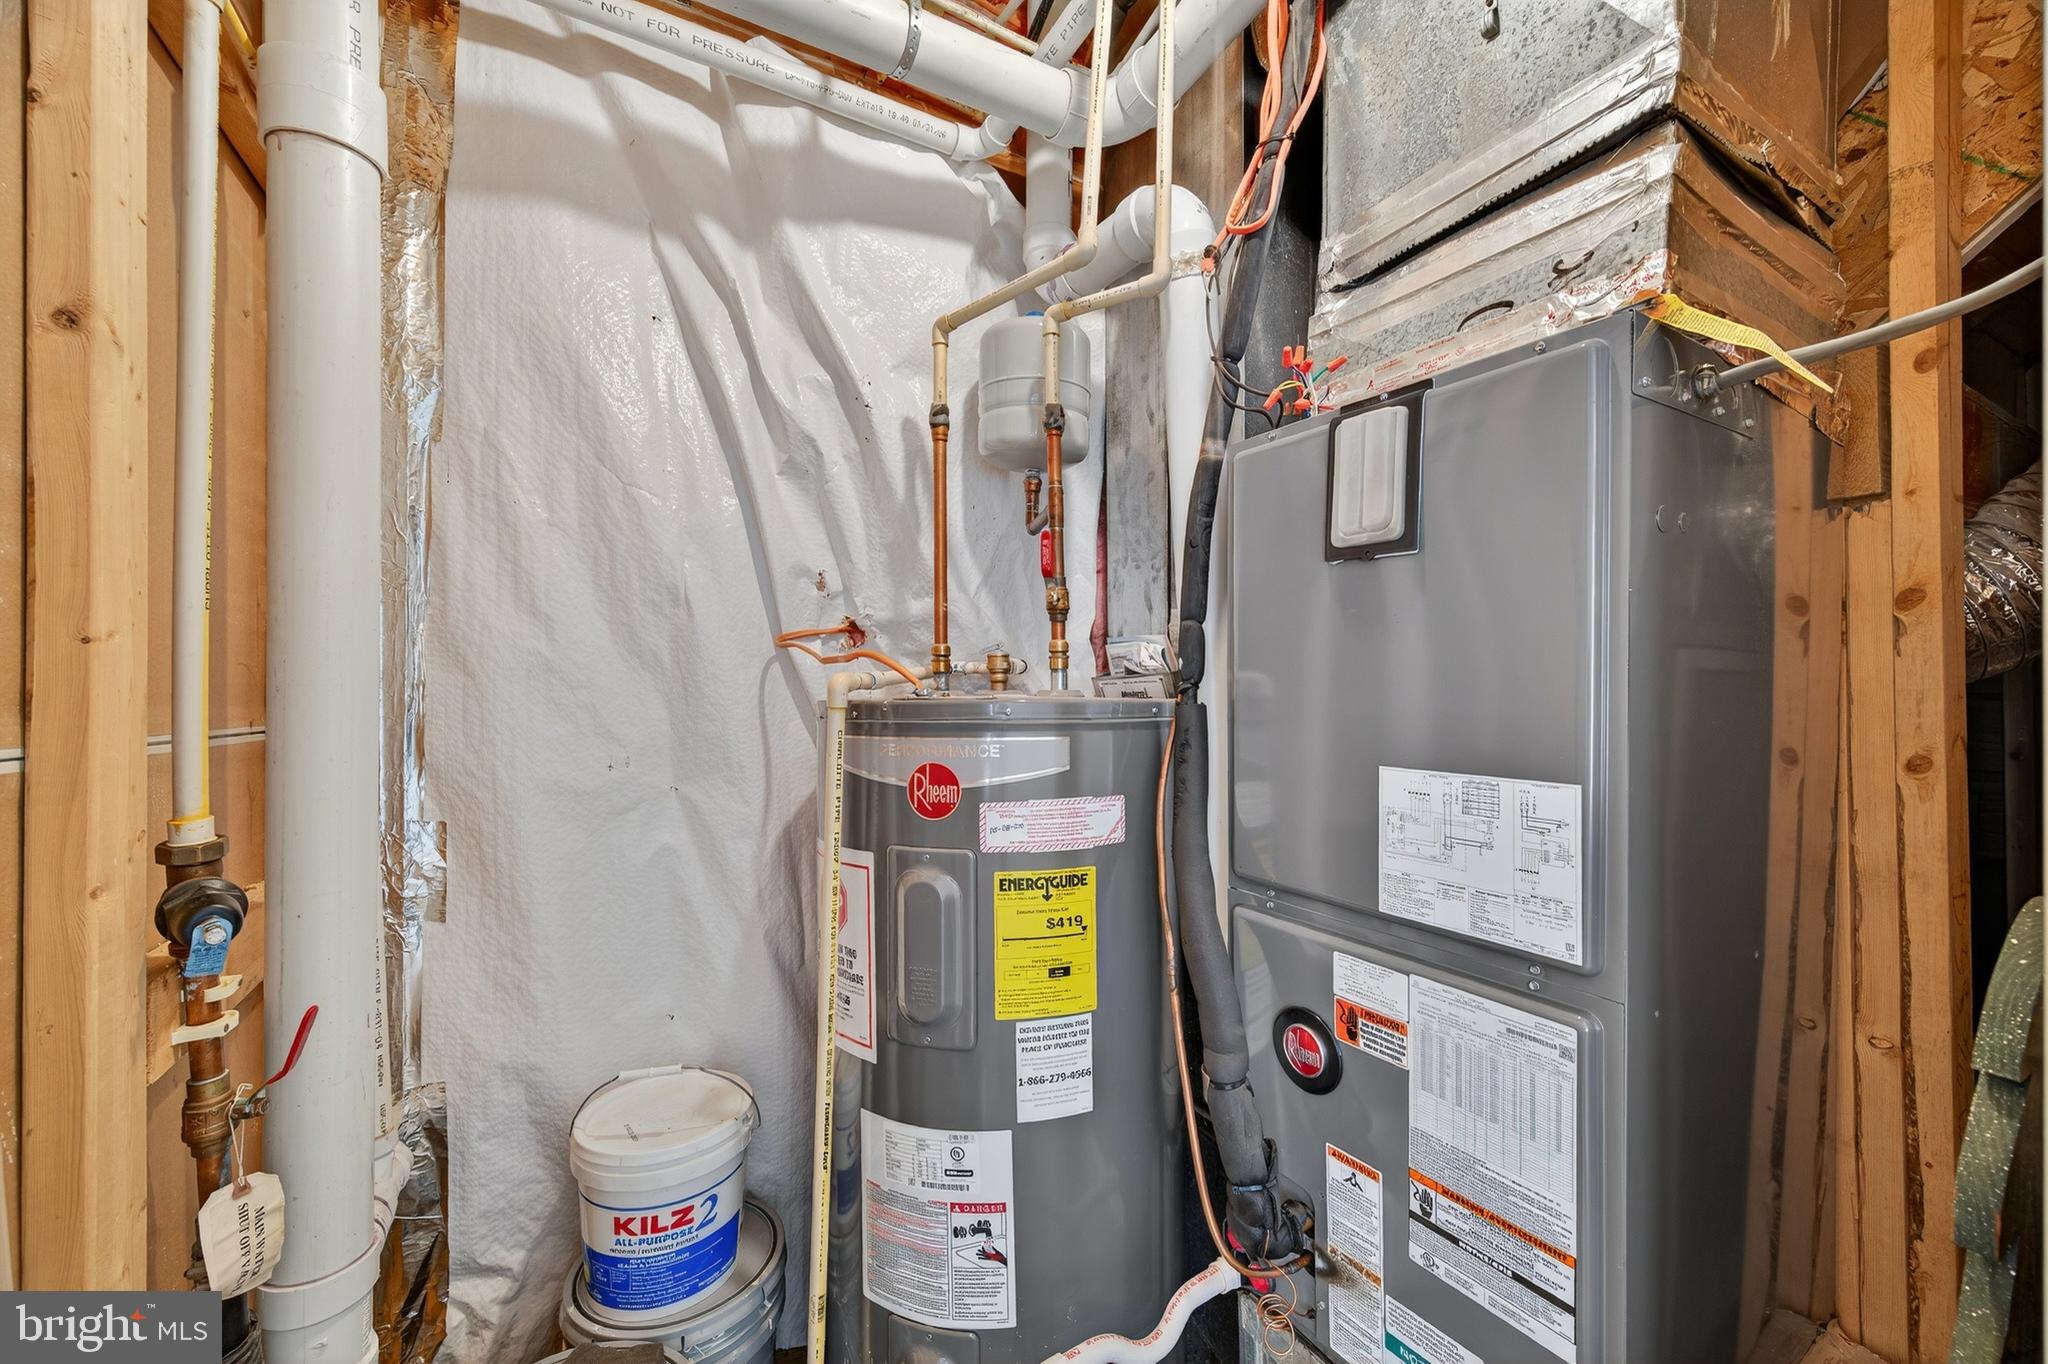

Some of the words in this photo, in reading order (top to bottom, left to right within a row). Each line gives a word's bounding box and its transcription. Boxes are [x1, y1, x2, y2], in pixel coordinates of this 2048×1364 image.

[600, 2, 635, 22] NOT
[646, 18, 681, 39] FOR
[691, 35, 776, 75] PRESSURE
[1059, 3, 1088, 42] PIPE
[913, 763, 958, 812] Rheem
[1045, 914, 1084, 930] $419
[238, 1202, 250, 1233] SHUT
[254, 1205, 266, 1238] MAIN
[613, 1204, 695, 1236] KILZ
[695, 1193, 719, 1232] 2
[240, 1235, 251, 1257] OFF
